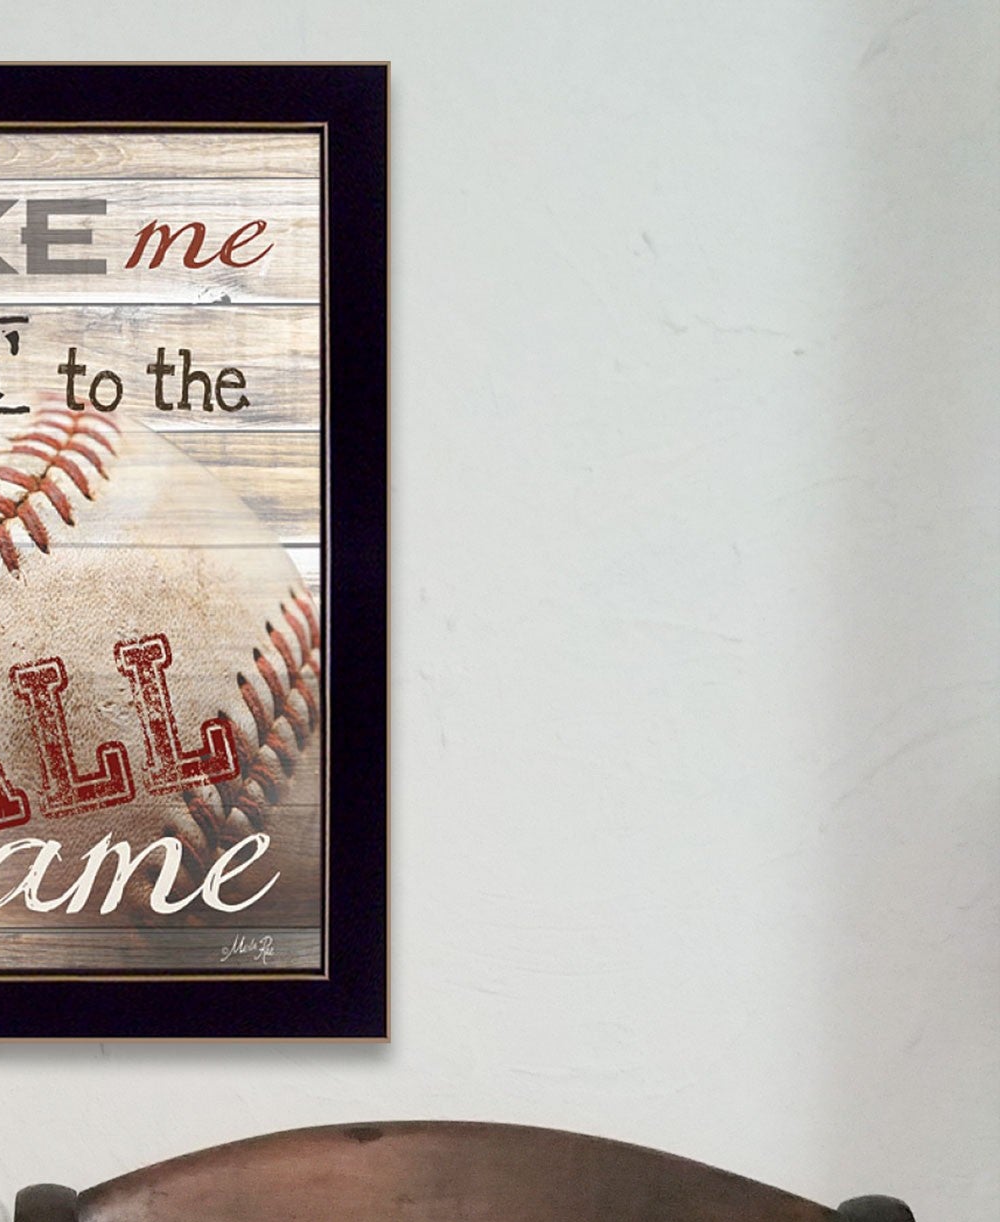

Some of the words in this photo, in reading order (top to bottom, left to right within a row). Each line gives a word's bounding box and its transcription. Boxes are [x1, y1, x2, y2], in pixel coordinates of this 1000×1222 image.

[124, 218, 275, 270] me
[57, 346, 123, 412] to
[146, 347, 251, 412] the
